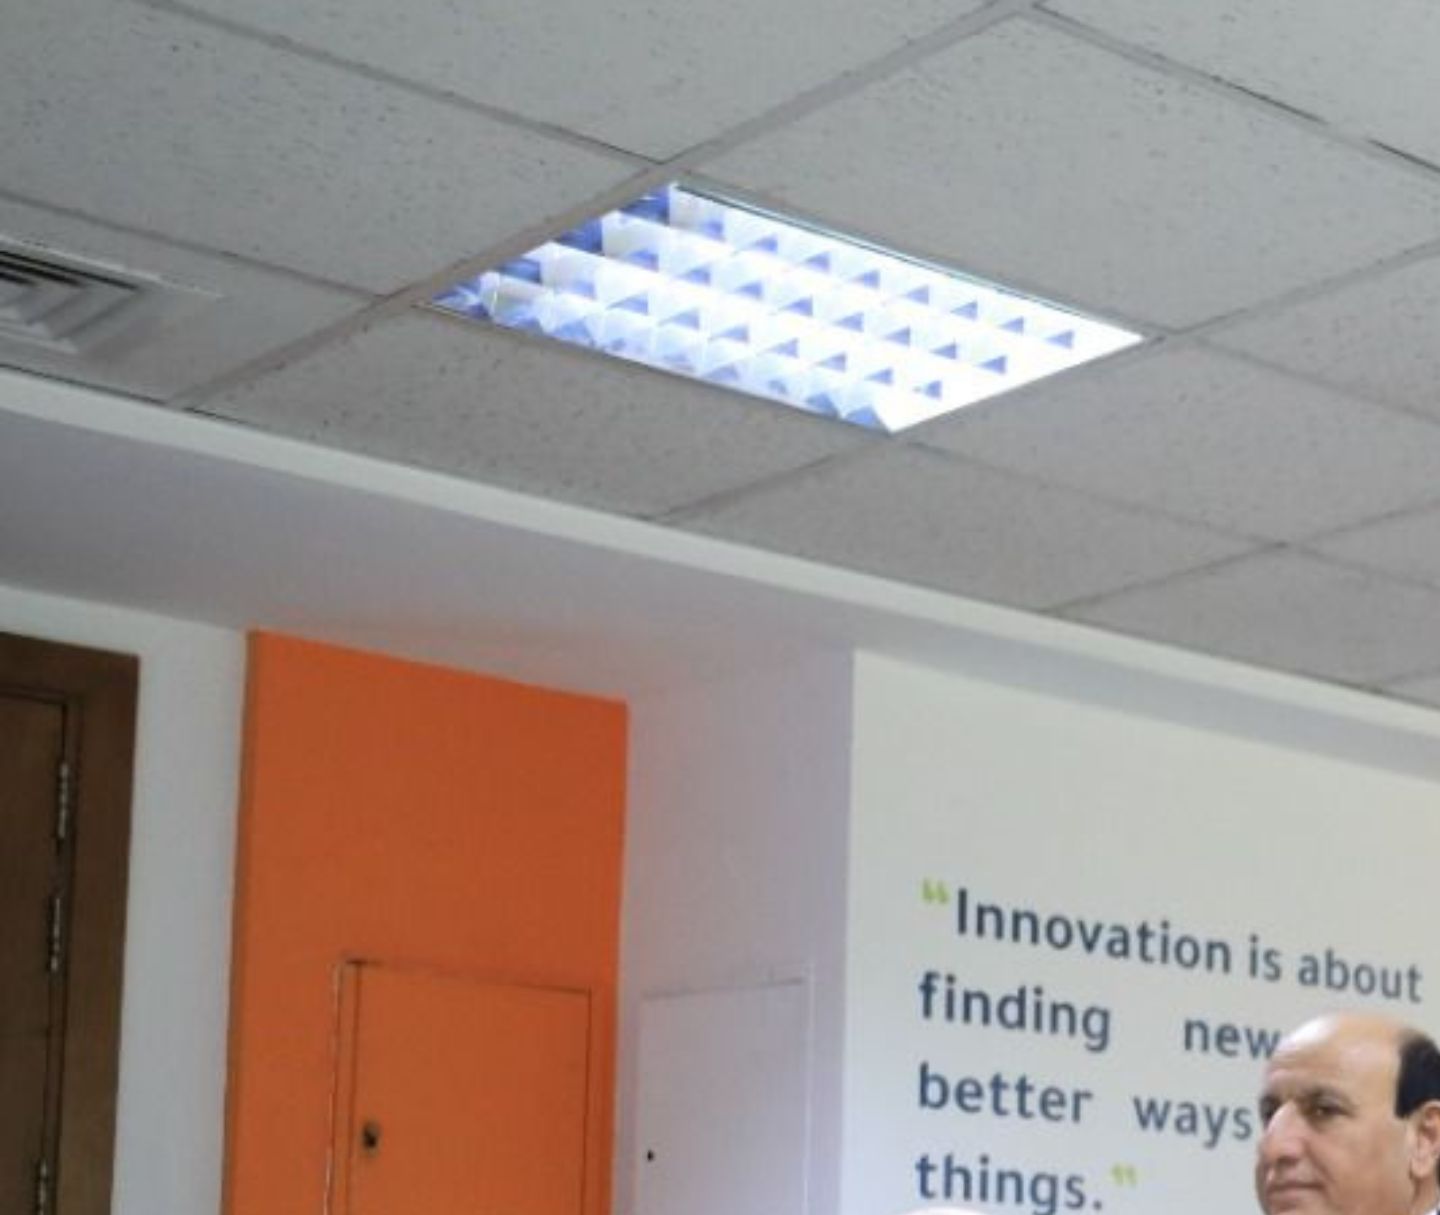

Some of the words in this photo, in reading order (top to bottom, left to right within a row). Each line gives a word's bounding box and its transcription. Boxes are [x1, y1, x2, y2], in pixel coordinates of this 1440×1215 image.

[918, 969, 1112, 1055] finding
[1183, 1017, 1283, 1060] new
[1248, 934, 1283, 982] is
[1297, 946, 1424, 1004] about
[918, 1060, 1095, 1123] better
[1132, 1093, 1254, 1151] ways
